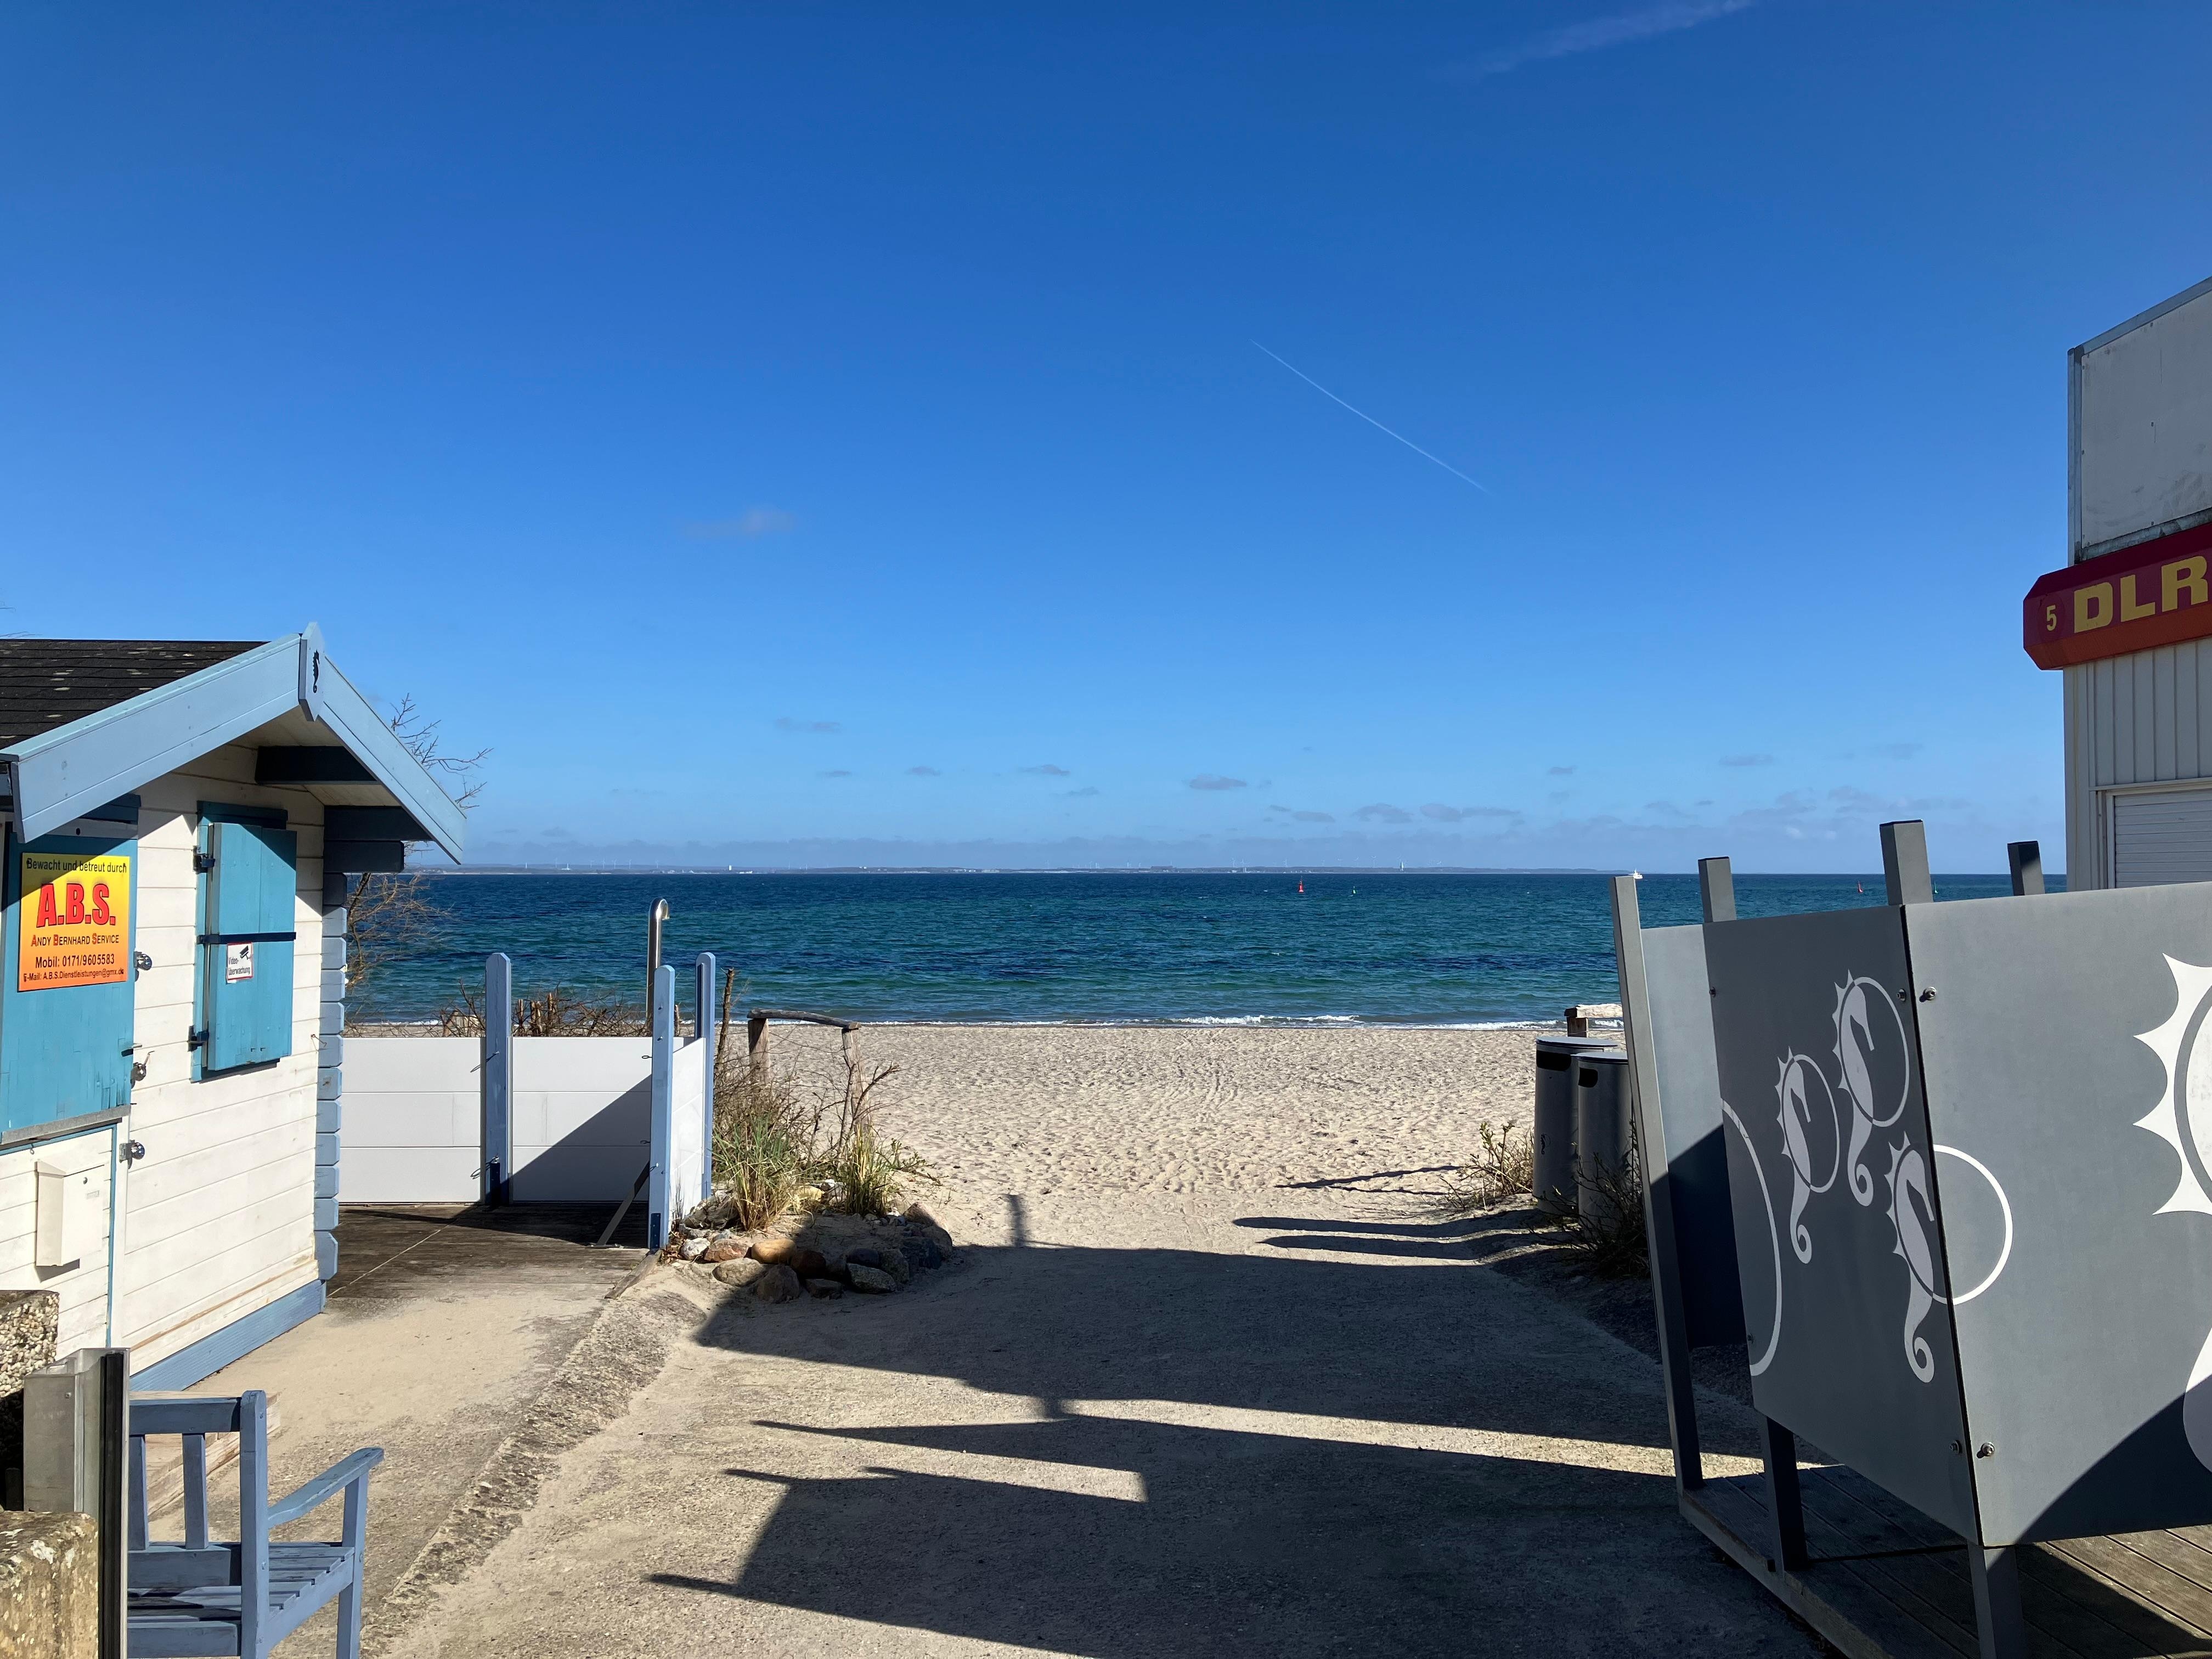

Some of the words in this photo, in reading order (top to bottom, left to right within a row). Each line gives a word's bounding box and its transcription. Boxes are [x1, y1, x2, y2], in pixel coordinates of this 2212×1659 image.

[2046, 605, 2057, 631] 5
[2074, 555, 2209, 634] DLR
[26, 857, 61, 870] Bewacht
[63, 861, 77, 871] und
[79, 861, 105, 872] betreut
[107, 862, 127, 873] durch
[36, 883, 116, 928] A.B.S.
[35, 956, 60, 968] Mobil:
[62, 953, 115, 967] 0171/9605583
[24, 972, 42, 982] E-Mail:
